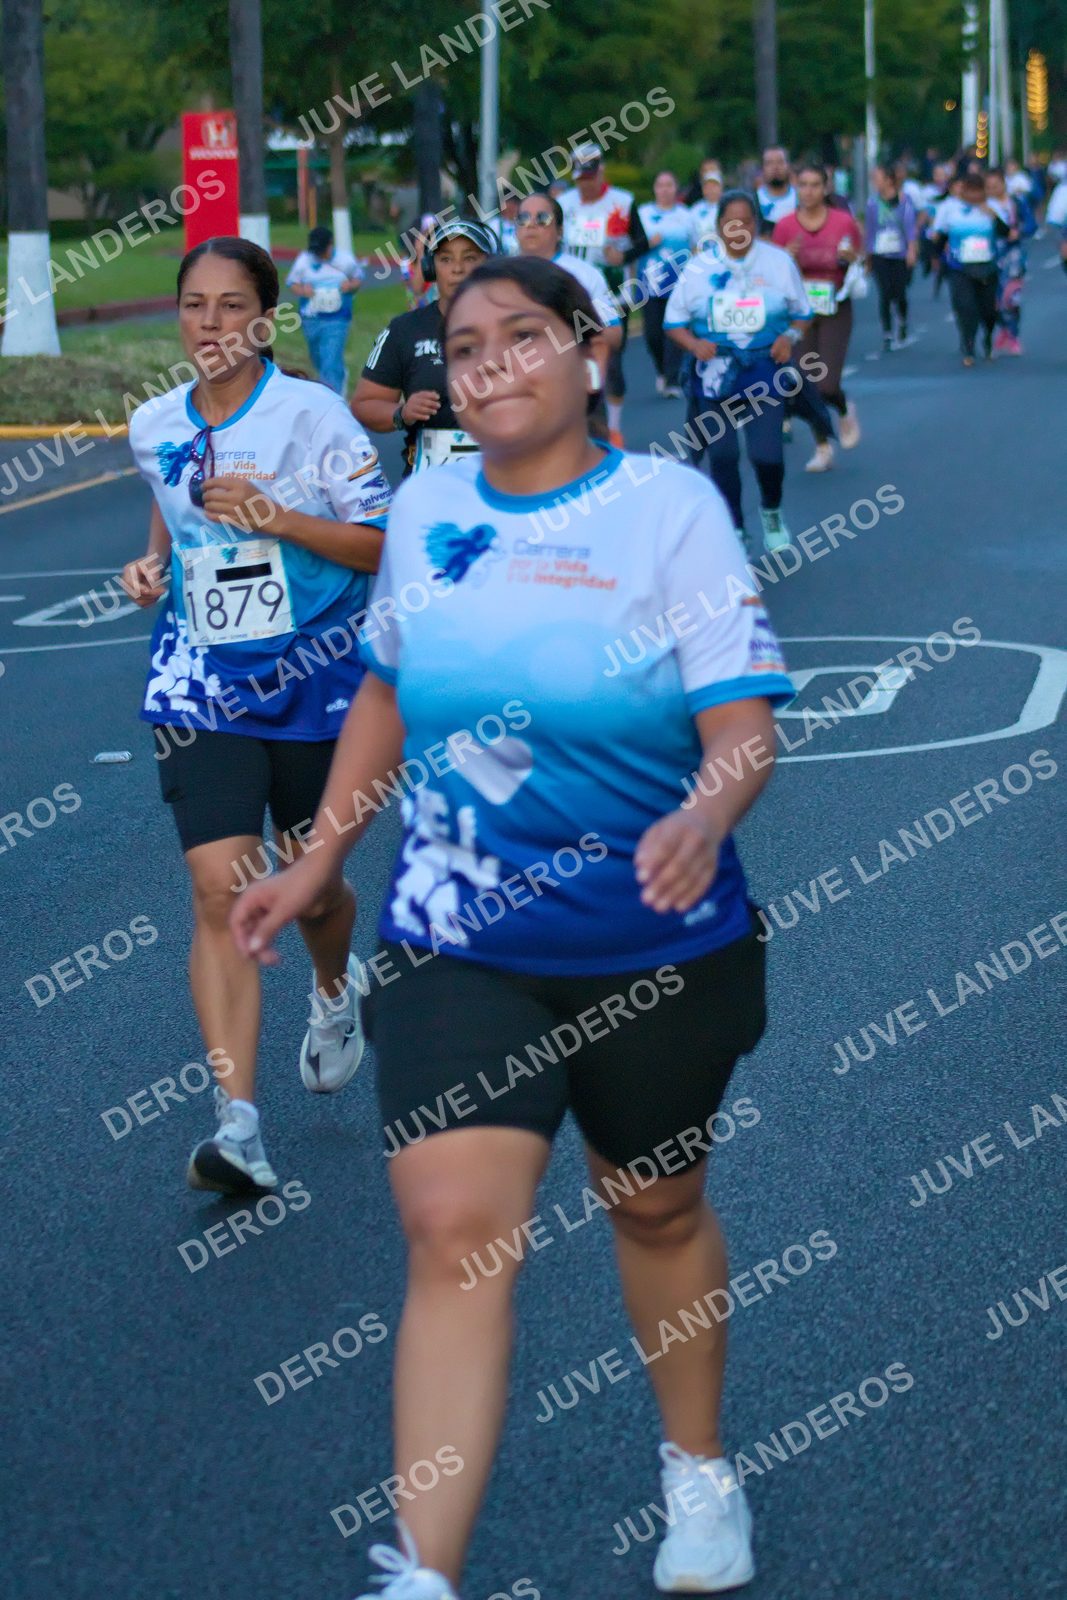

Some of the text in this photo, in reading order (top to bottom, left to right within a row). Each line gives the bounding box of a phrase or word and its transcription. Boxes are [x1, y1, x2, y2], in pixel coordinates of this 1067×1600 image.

[721, 308, 758, 328] 506
[213, 450, 257, 461] arrera
[233, 460, 257, 471] Vida
[186, 580, 285, 632] 1879
